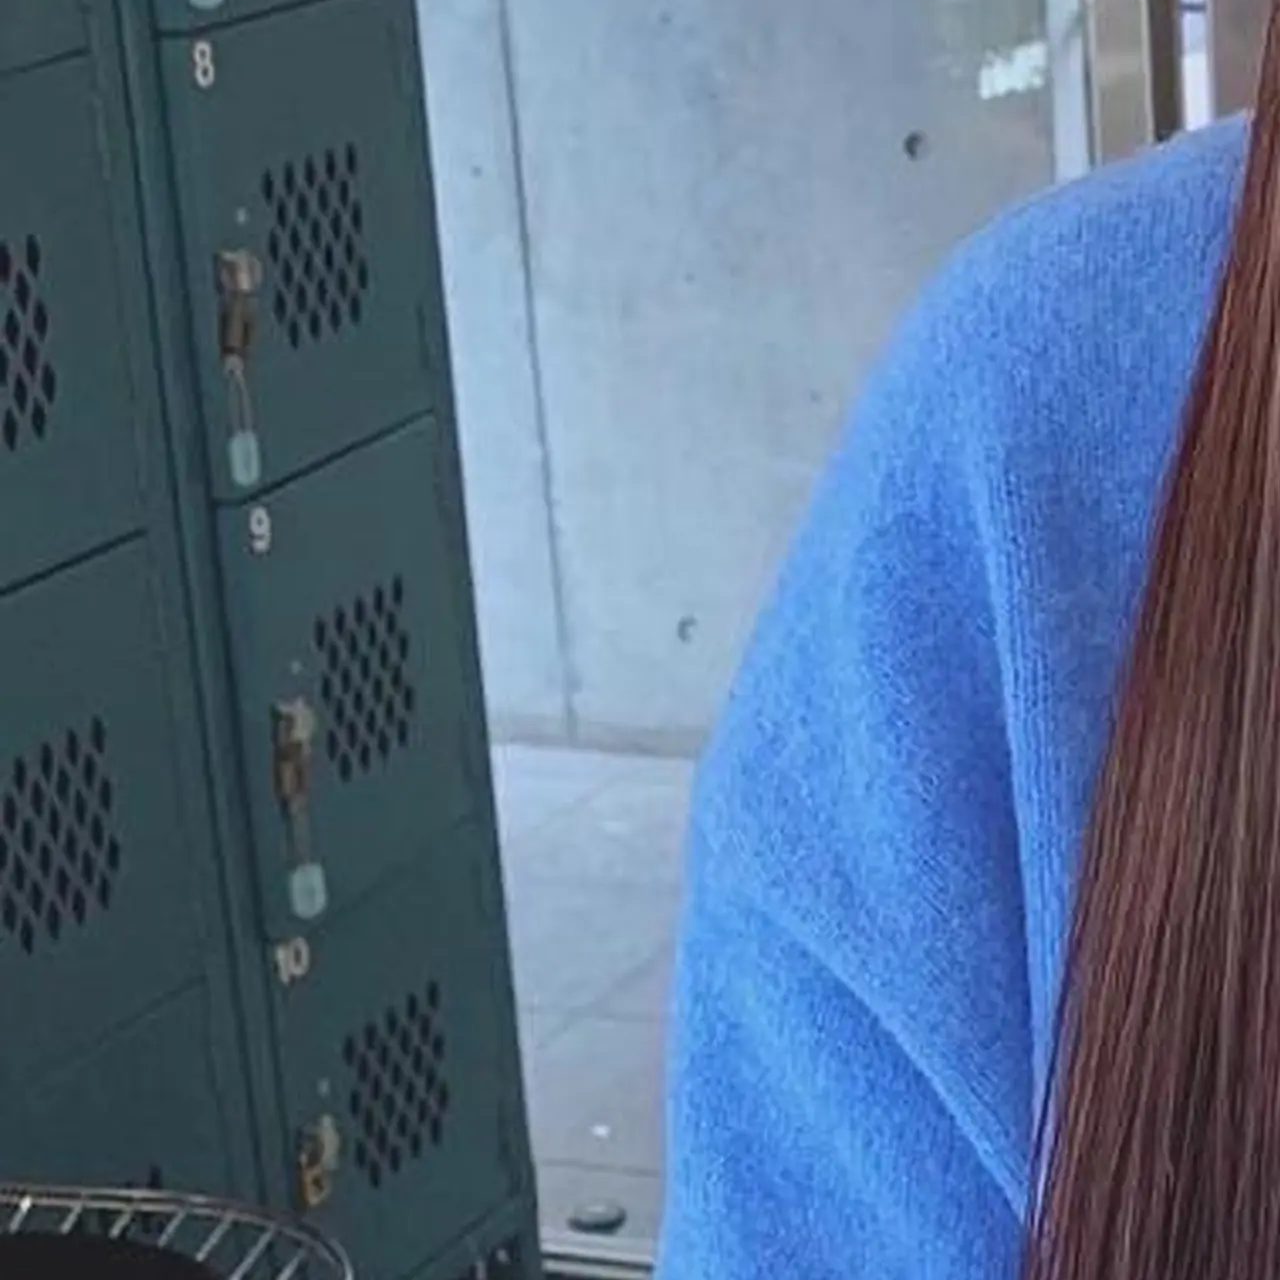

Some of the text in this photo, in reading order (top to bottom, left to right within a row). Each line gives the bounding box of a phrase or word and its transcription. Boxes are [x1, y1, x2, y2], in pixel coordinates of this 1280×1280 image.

[192, 40, 215, 89] 8
[249, 506, 272, 554] 9
[276, 937, 310, 985] 10
